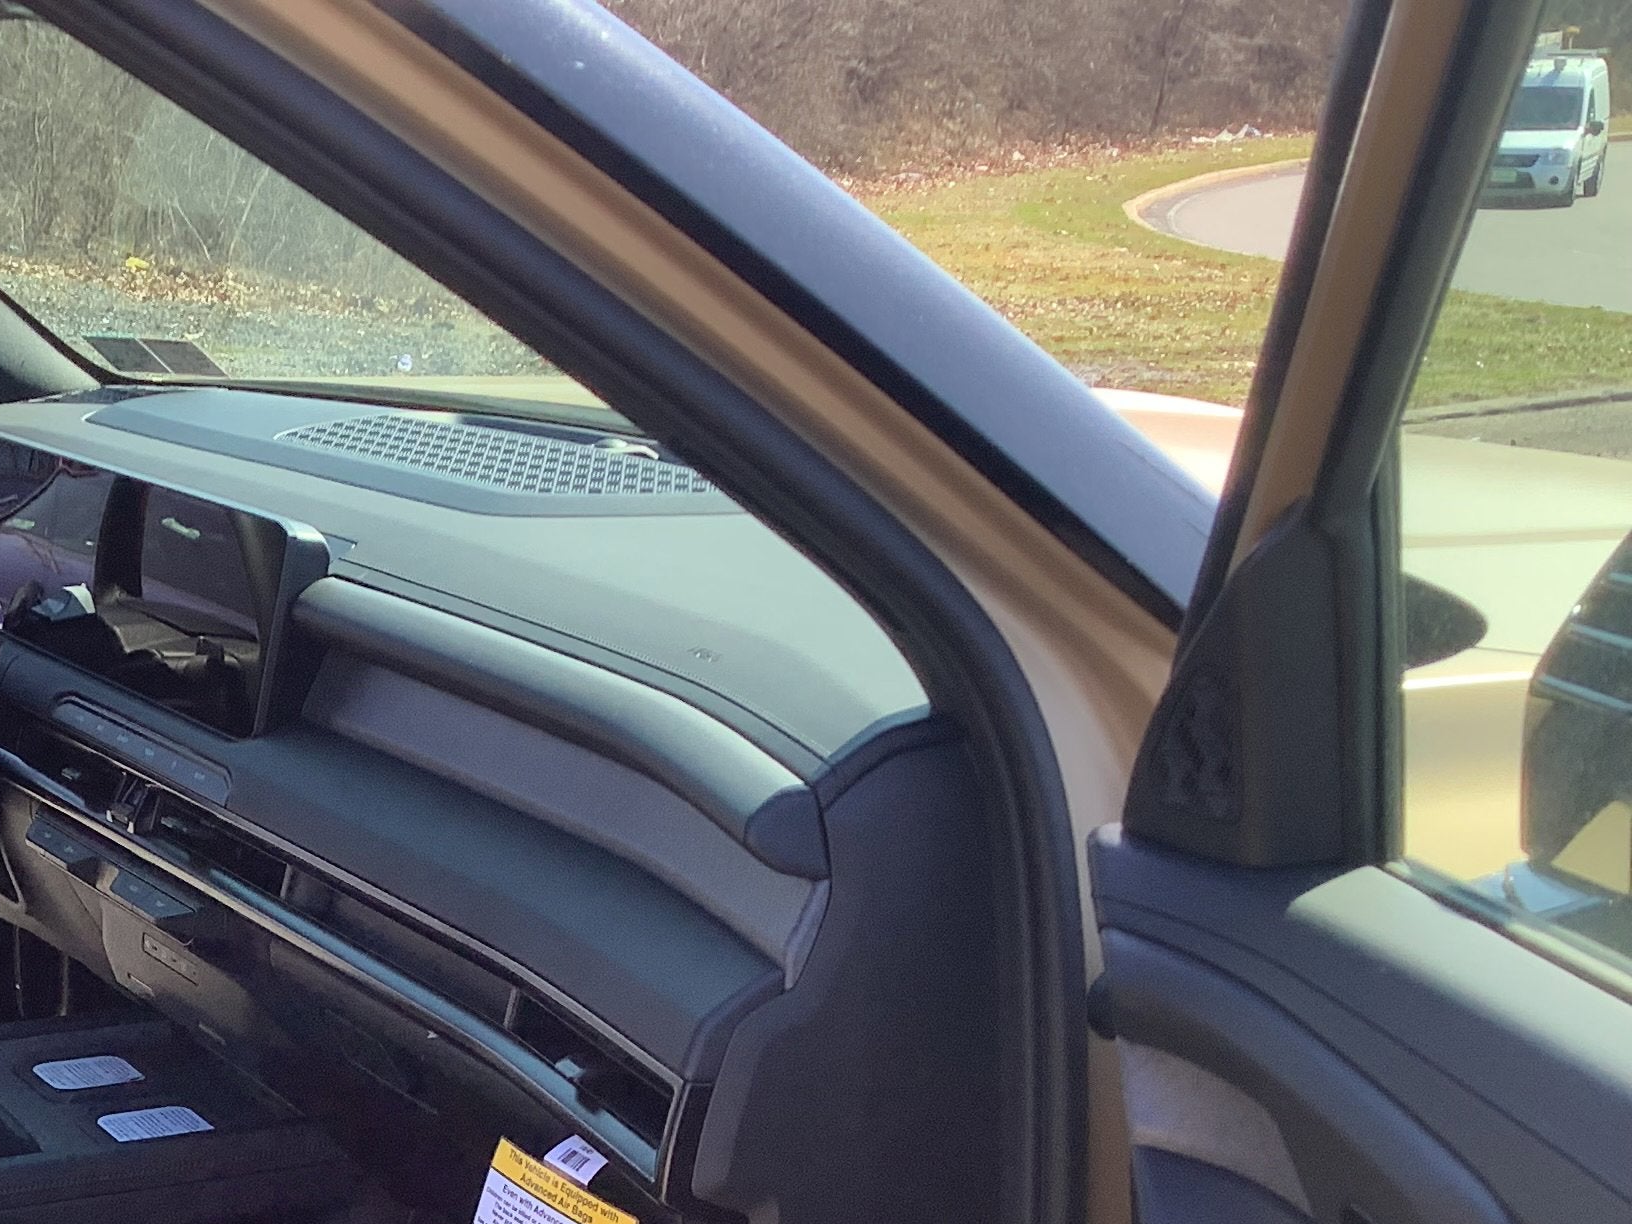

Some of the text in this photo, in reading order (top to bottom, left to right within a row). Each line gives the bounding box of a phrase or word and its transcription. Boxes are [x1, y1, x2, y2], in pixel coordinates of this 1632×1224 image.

[502, 1184, 519, 1200] Even
[519, 1196, 533, 1210] with
[508, 1149, 619, 1223] This Vehicle is Equipped with
[521, 1174, 592, 1223] Advanced Air Bags
